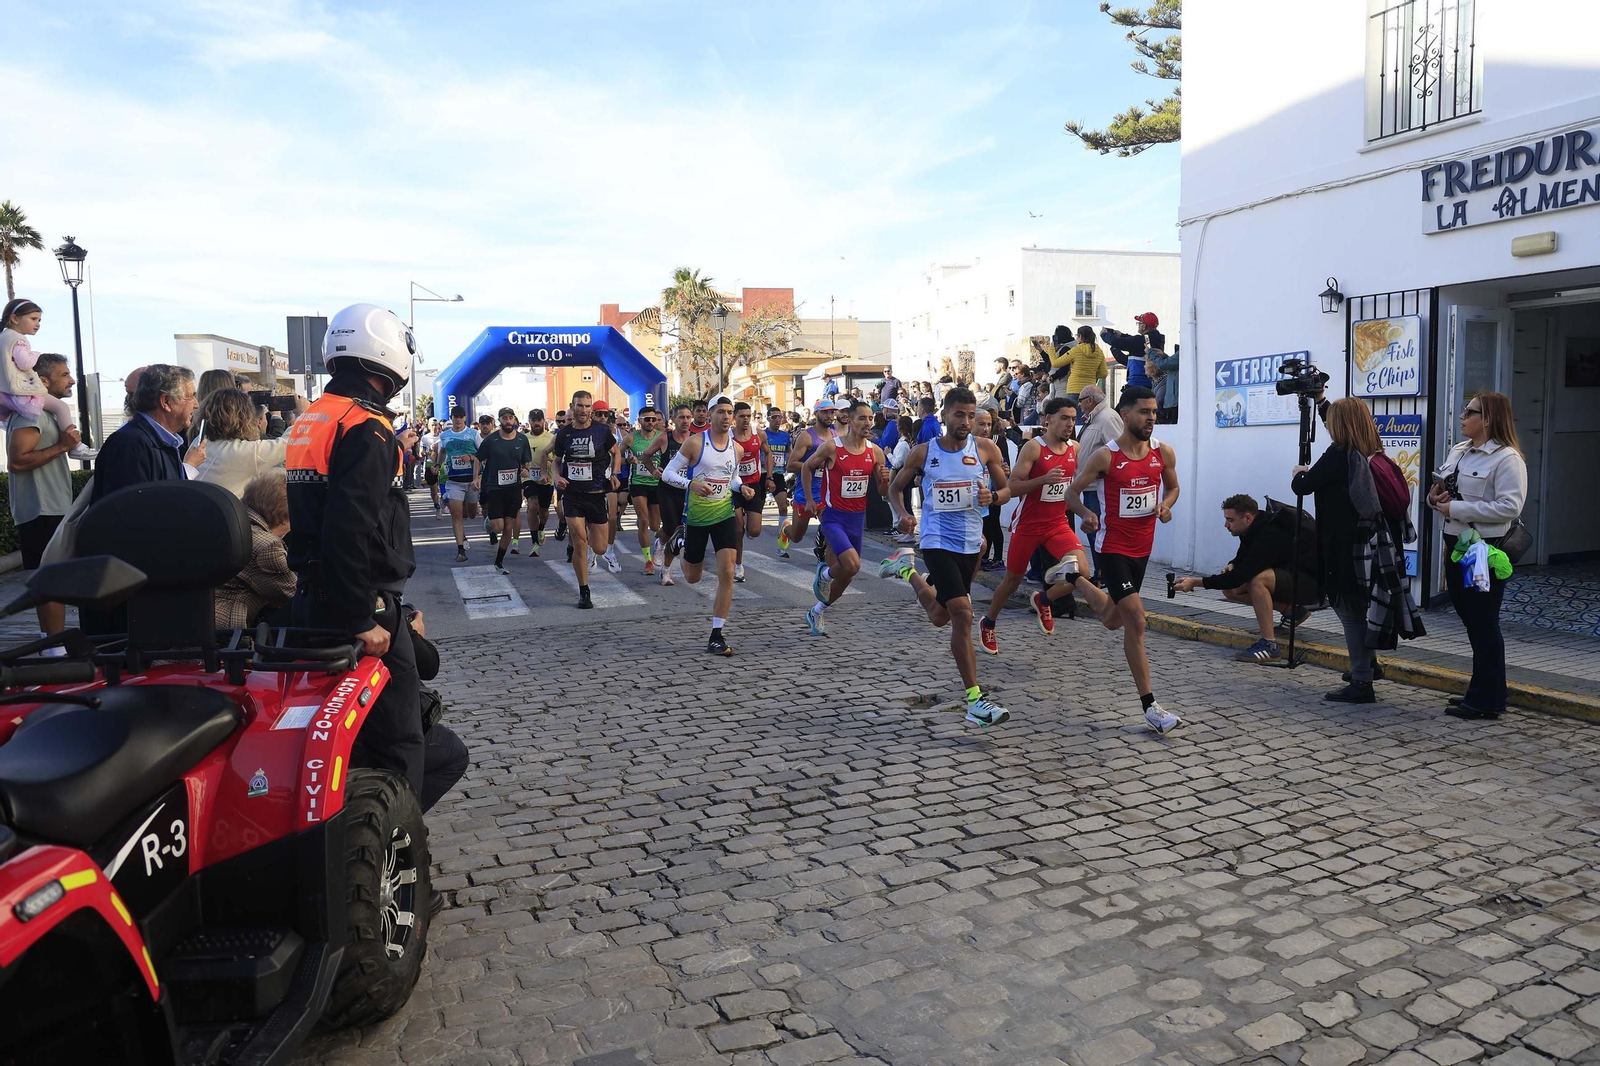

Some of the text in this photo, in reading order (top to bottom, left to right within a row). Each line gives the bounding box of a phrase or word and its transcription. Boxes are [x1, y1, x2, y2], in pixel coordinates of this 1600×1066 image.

[1421, 130, 1600, 202] FREIDUR
[1436, 200, 1468, 230] LA
[508, 331, 591, 347] Cruzcampo
[537, 348, 563, 361] 0.0
[1387, 338, 1416, 362] Fish
[1366, 366, 1415, 393] & Chips
[1385, 416, 1420, 436] Away
[572, 437, 589, 445] XVI
[501, 473, 514, 481] 330
[571, 466, 584, 475] 241
[846, 482, 862, 491] 224
[1047, 484, 1065, 495] 292
[938, 489, 960, 503] 351
[1126, 495, 1147, 509] 291
[305, 759, 324, 822] CIVIL
[141, 819, 187, 877] R-3
